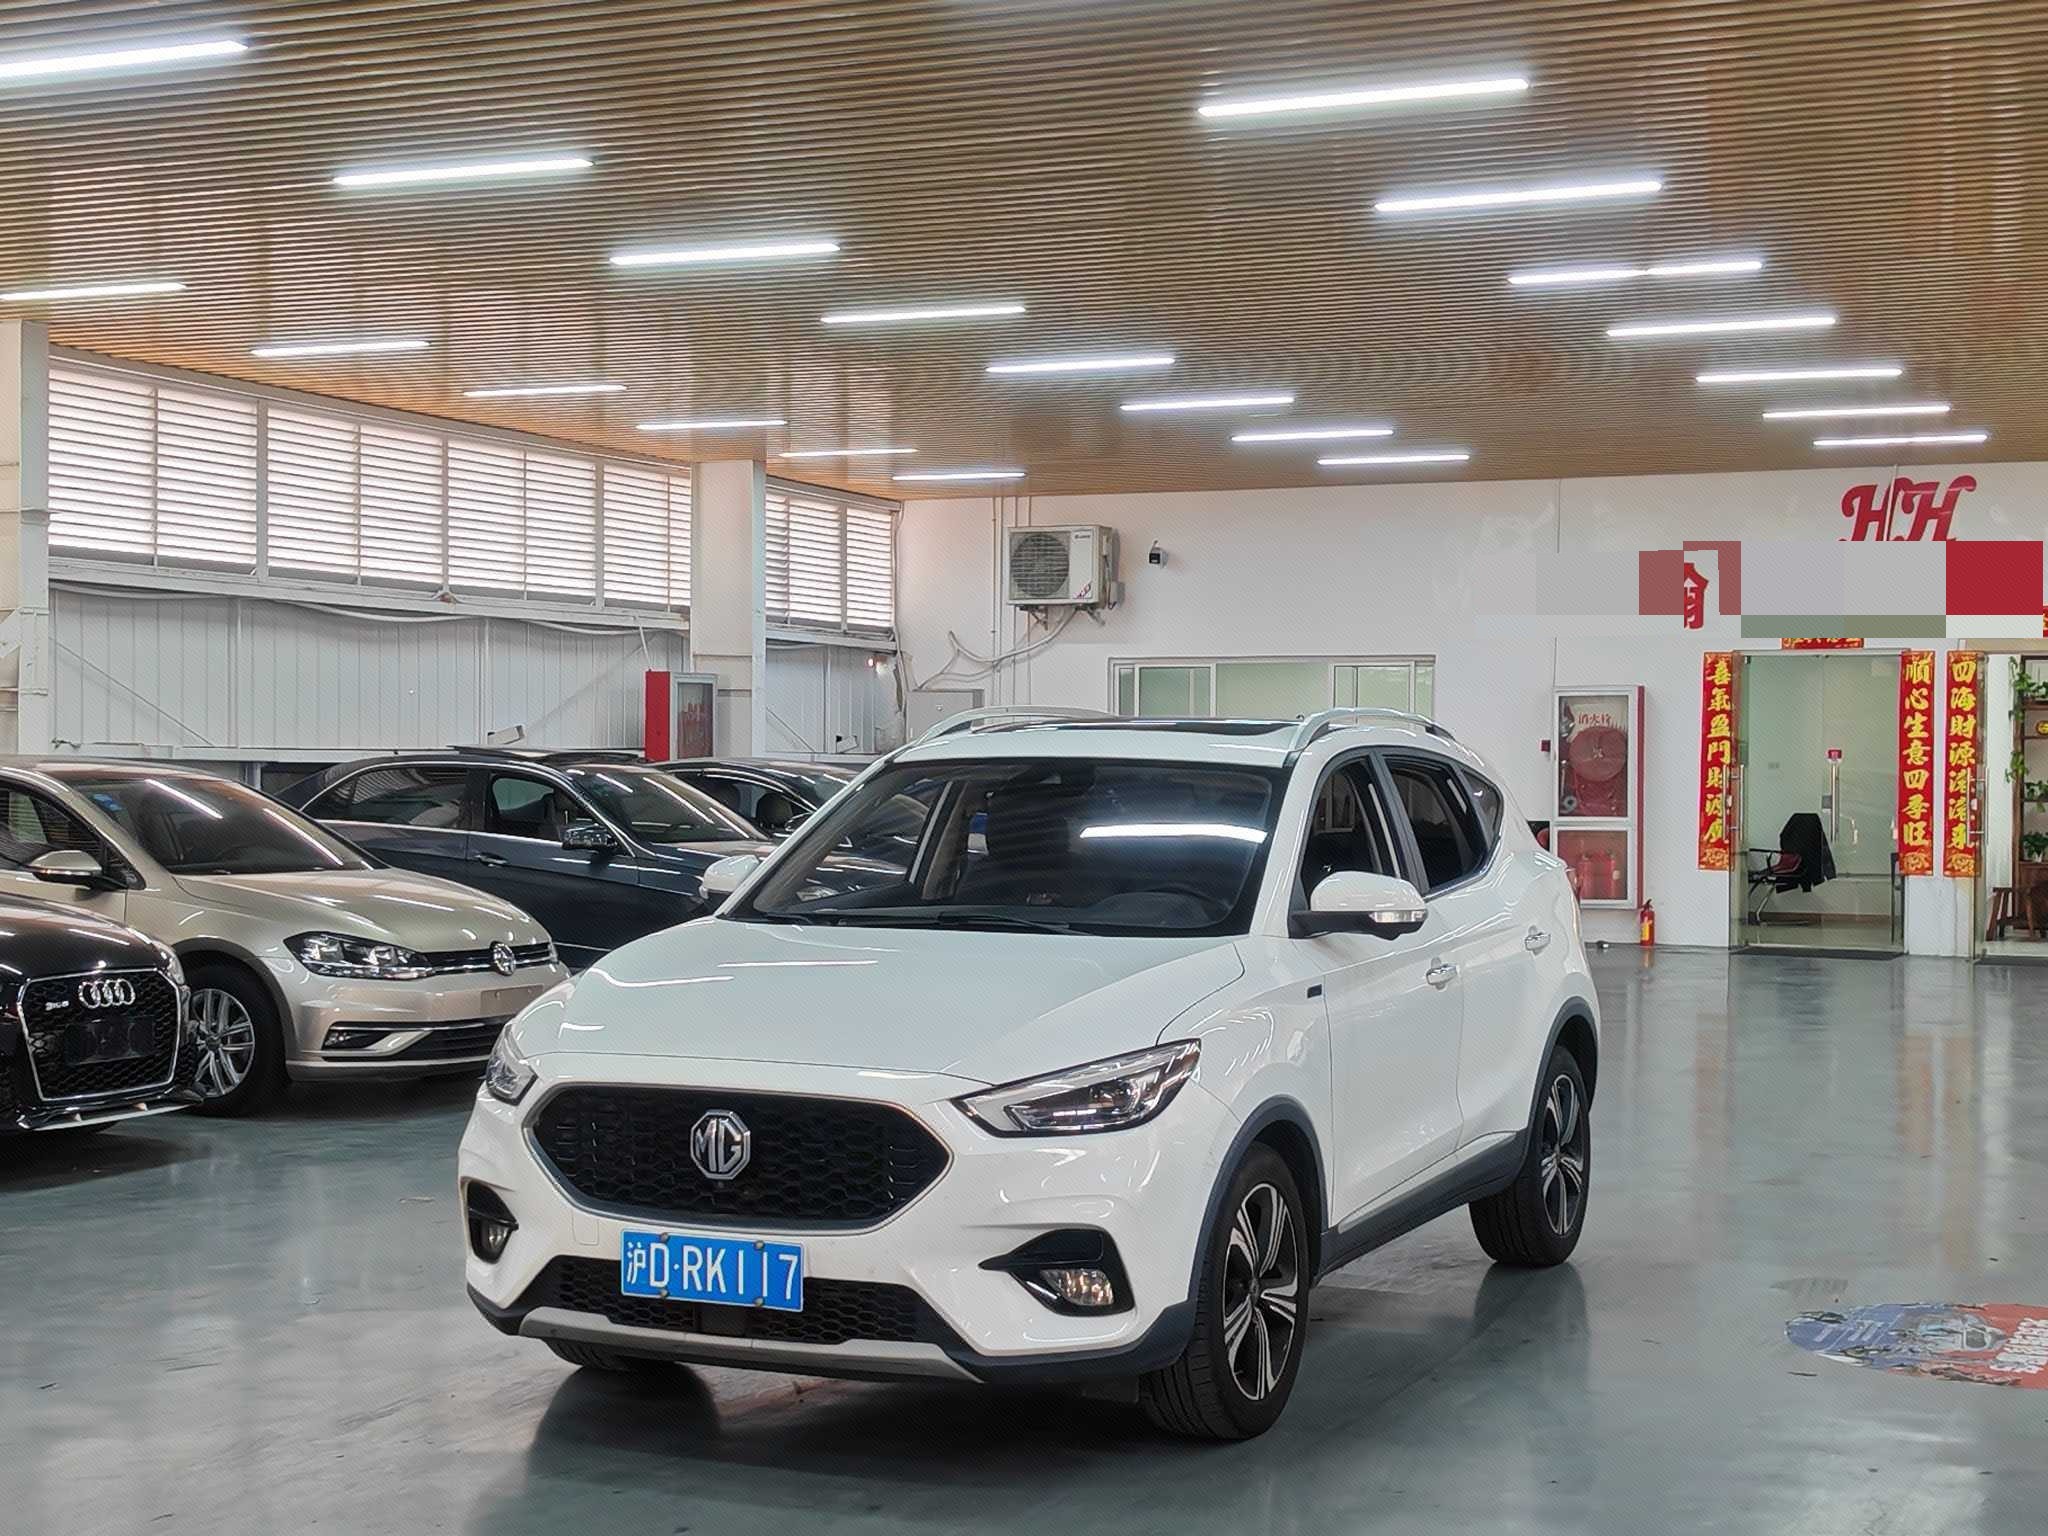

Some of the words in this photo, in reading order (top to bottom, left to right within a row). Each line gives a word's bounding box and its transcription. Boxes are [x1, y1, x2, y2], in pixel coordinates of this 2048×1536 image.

[1903, 658, 1930, 846] 順心生意四季旺
[695, 1117, 742, 1173] MG
